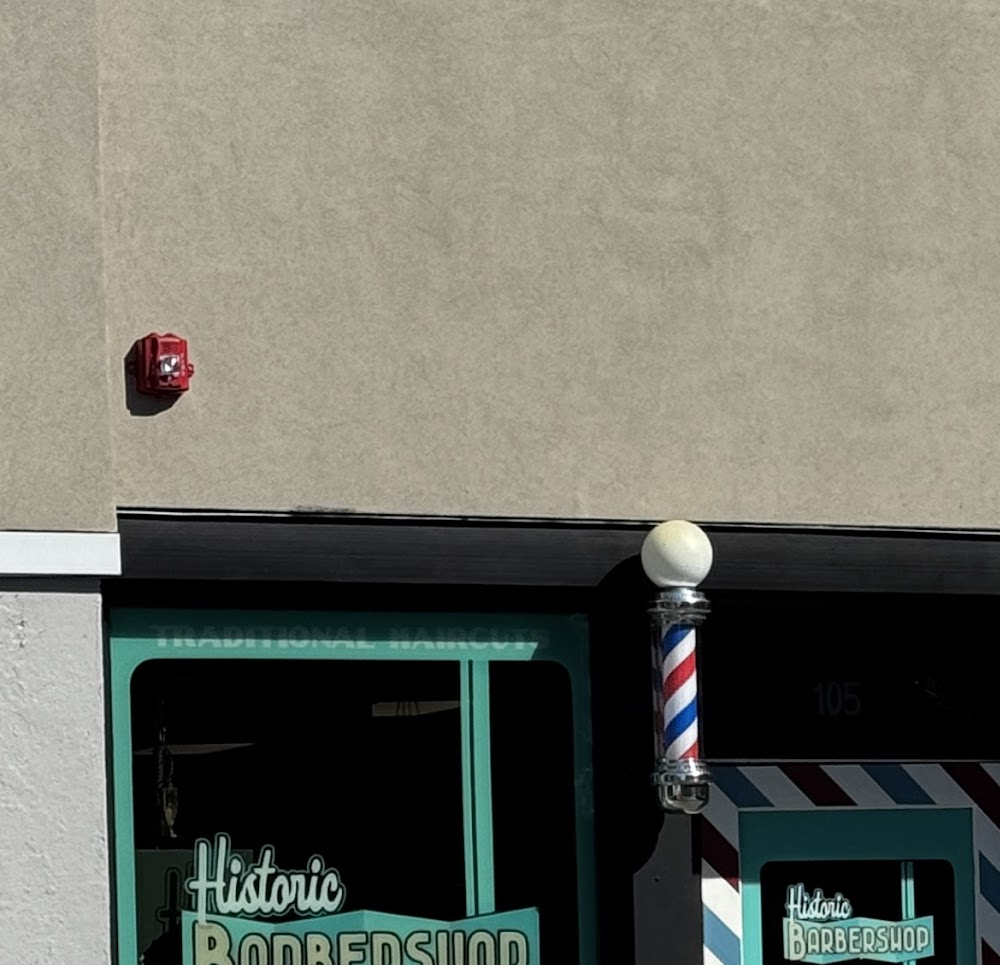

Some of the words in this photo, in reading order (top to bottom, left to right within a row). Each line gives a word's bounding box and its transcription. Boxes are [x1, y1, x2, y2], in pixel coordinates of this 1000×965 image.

[153, 624, 375, 650] TRADITIONAL
[388, 625, 549, 651] HAIRCUTS
[813, 681, 863, 718] 105
[188, 835, 344, 924] Historic
[786, 883, 852, 923] Historic
[788, 921, 929, 961] BARBERSHOP
